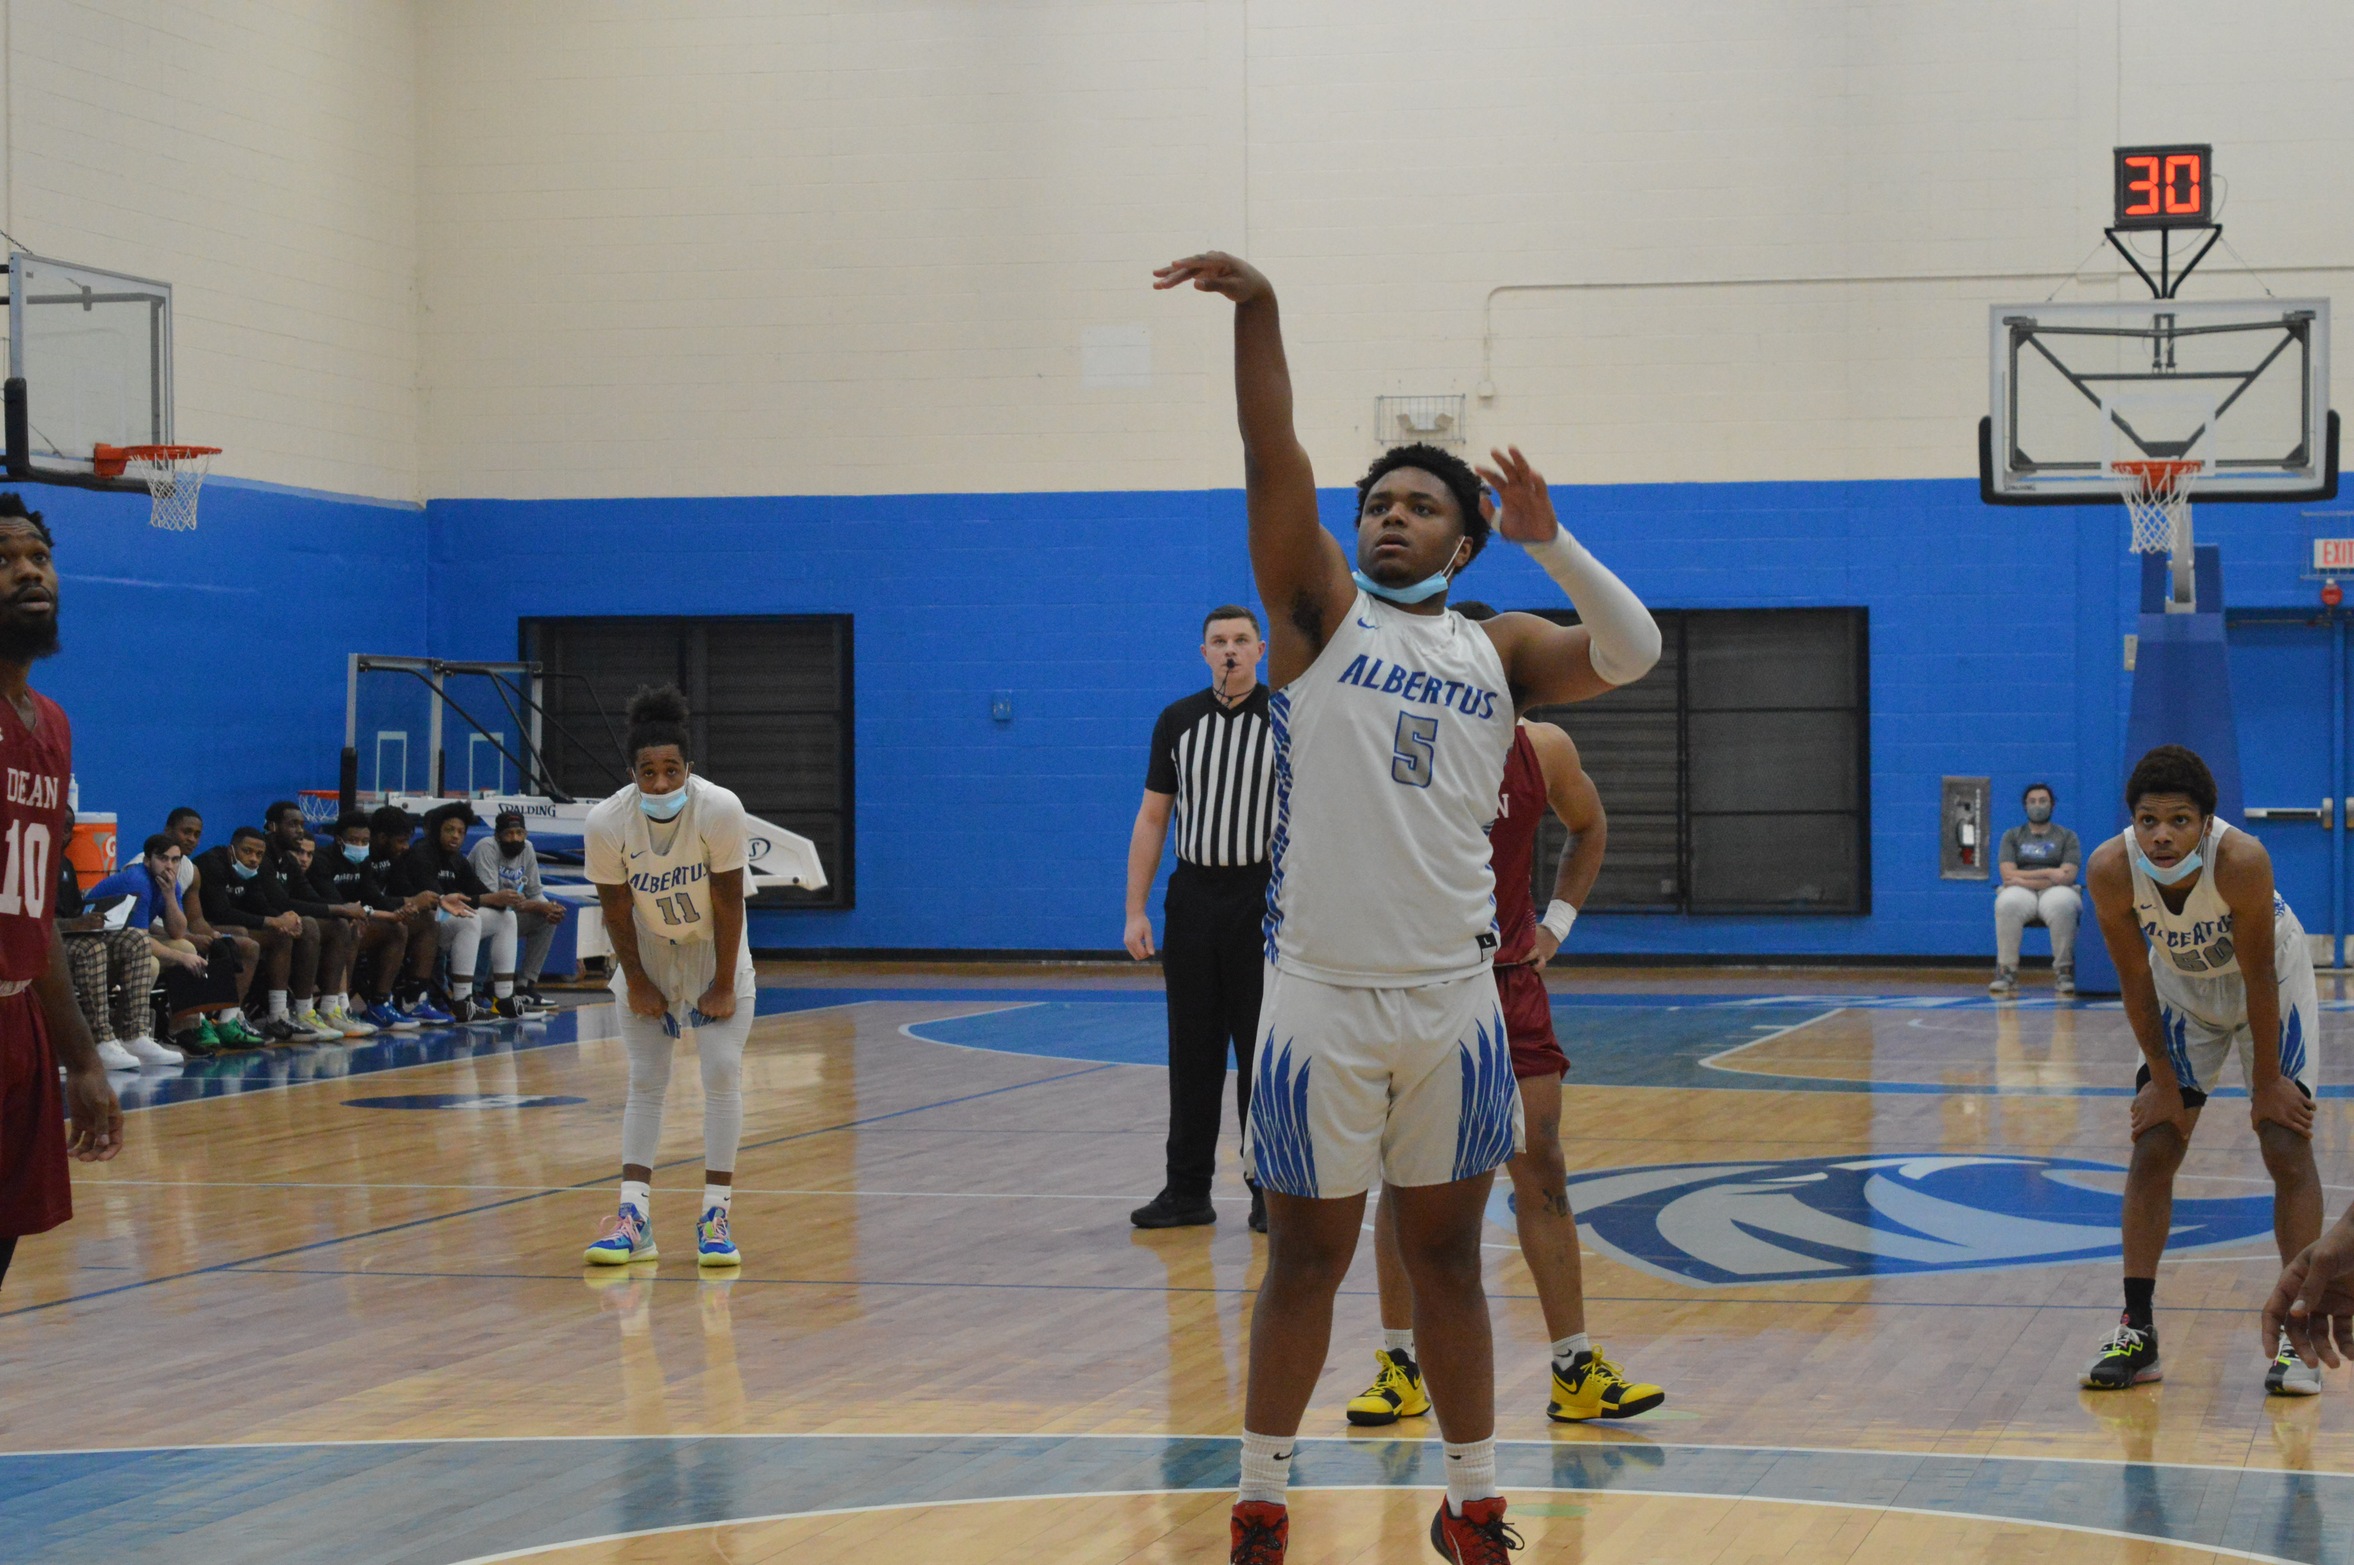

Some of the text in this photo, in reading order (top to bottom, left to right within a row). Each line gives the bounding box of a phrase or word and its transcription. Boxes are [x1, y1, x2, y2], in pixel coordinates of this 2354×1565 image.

[2125, 155, 2200, 215] 30
[1337, 653, 1498, 720] ALBERTUS
[1391, 709, 1439, 789] 5
[7, 767, 59, 810] DEAN
[498, 803, 557, 818] SPALDING
[0, 819, 51, 919] 10
[629, 862, 708, 893] ALBERTU
[655, 892, 701, 926] 11
[2169, 936, 2235, 972] 50
